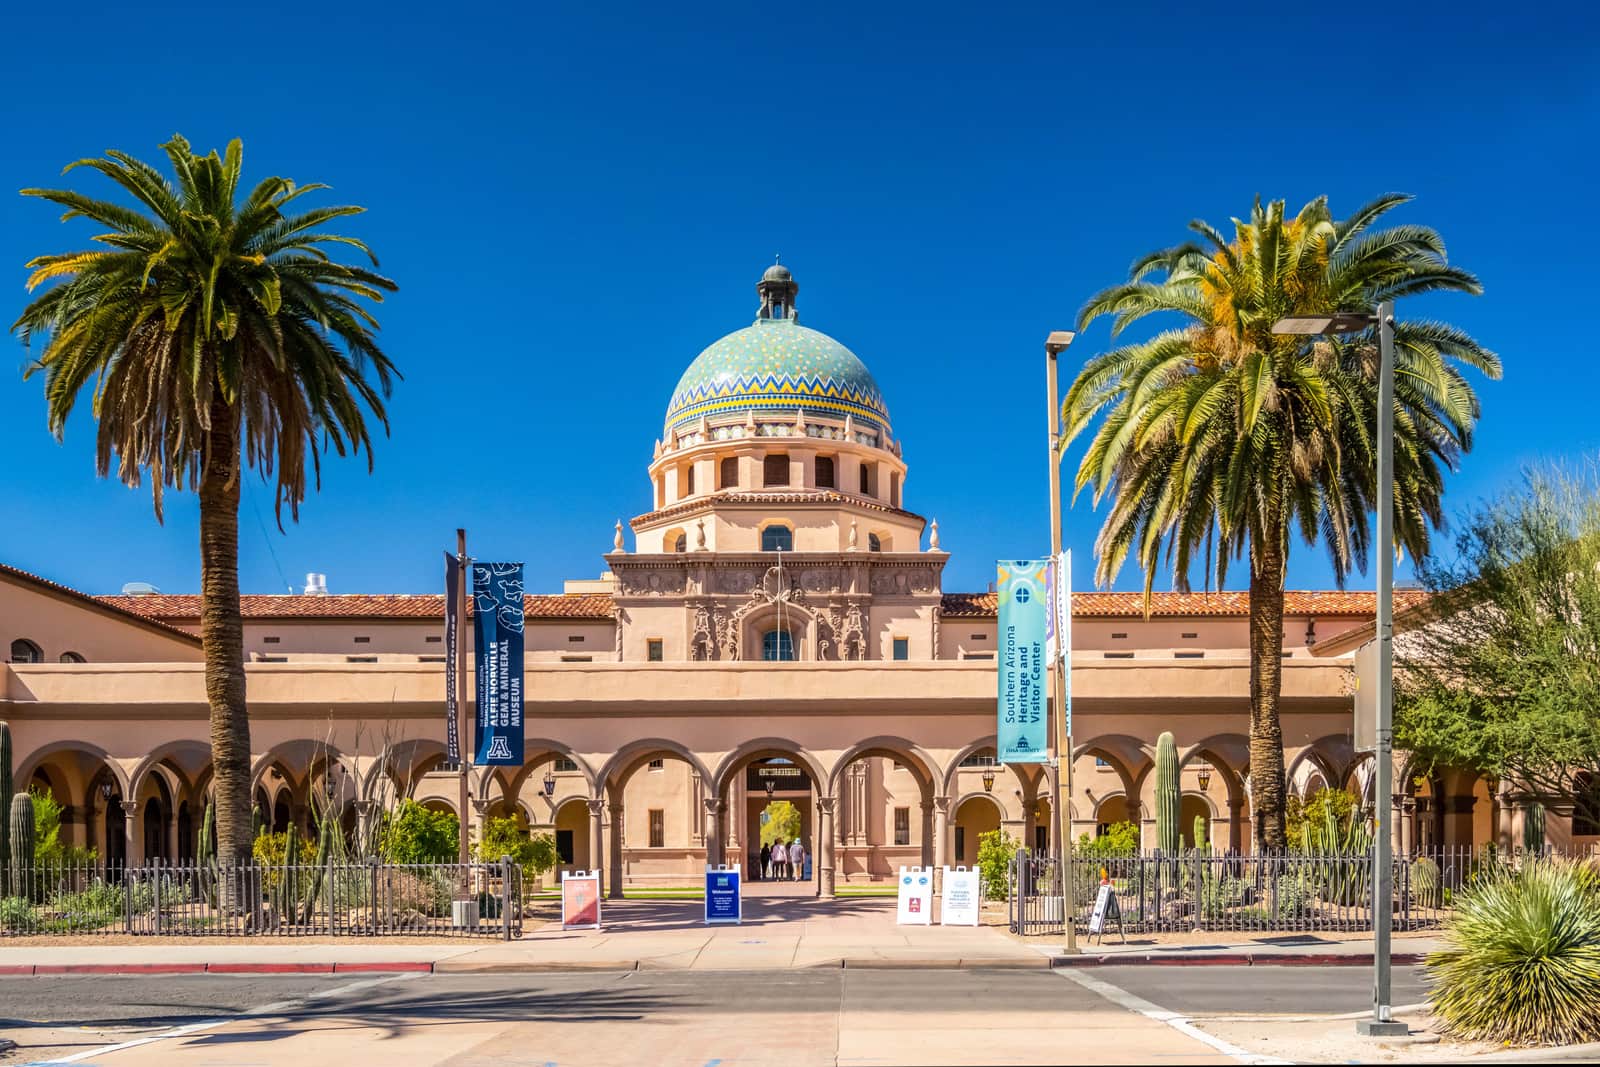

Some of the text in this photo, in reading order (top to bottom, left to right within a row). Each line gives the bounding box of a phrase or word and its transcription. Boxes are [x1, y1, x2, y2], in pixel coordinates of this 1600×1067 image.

[490, 642, 498, 727] ALFIE NORVILLE
[500, 640, 509, 727] GEM & MINERAL
[511, 678, 520, 727] MUSEUM
[1004, 626, 1015, 724] Southern Arizona
[1018, 647, 1030, 723] Heritage and
[1030, 641, 1040, 724] Visitor Center
[486, 736, 512, 759] A
